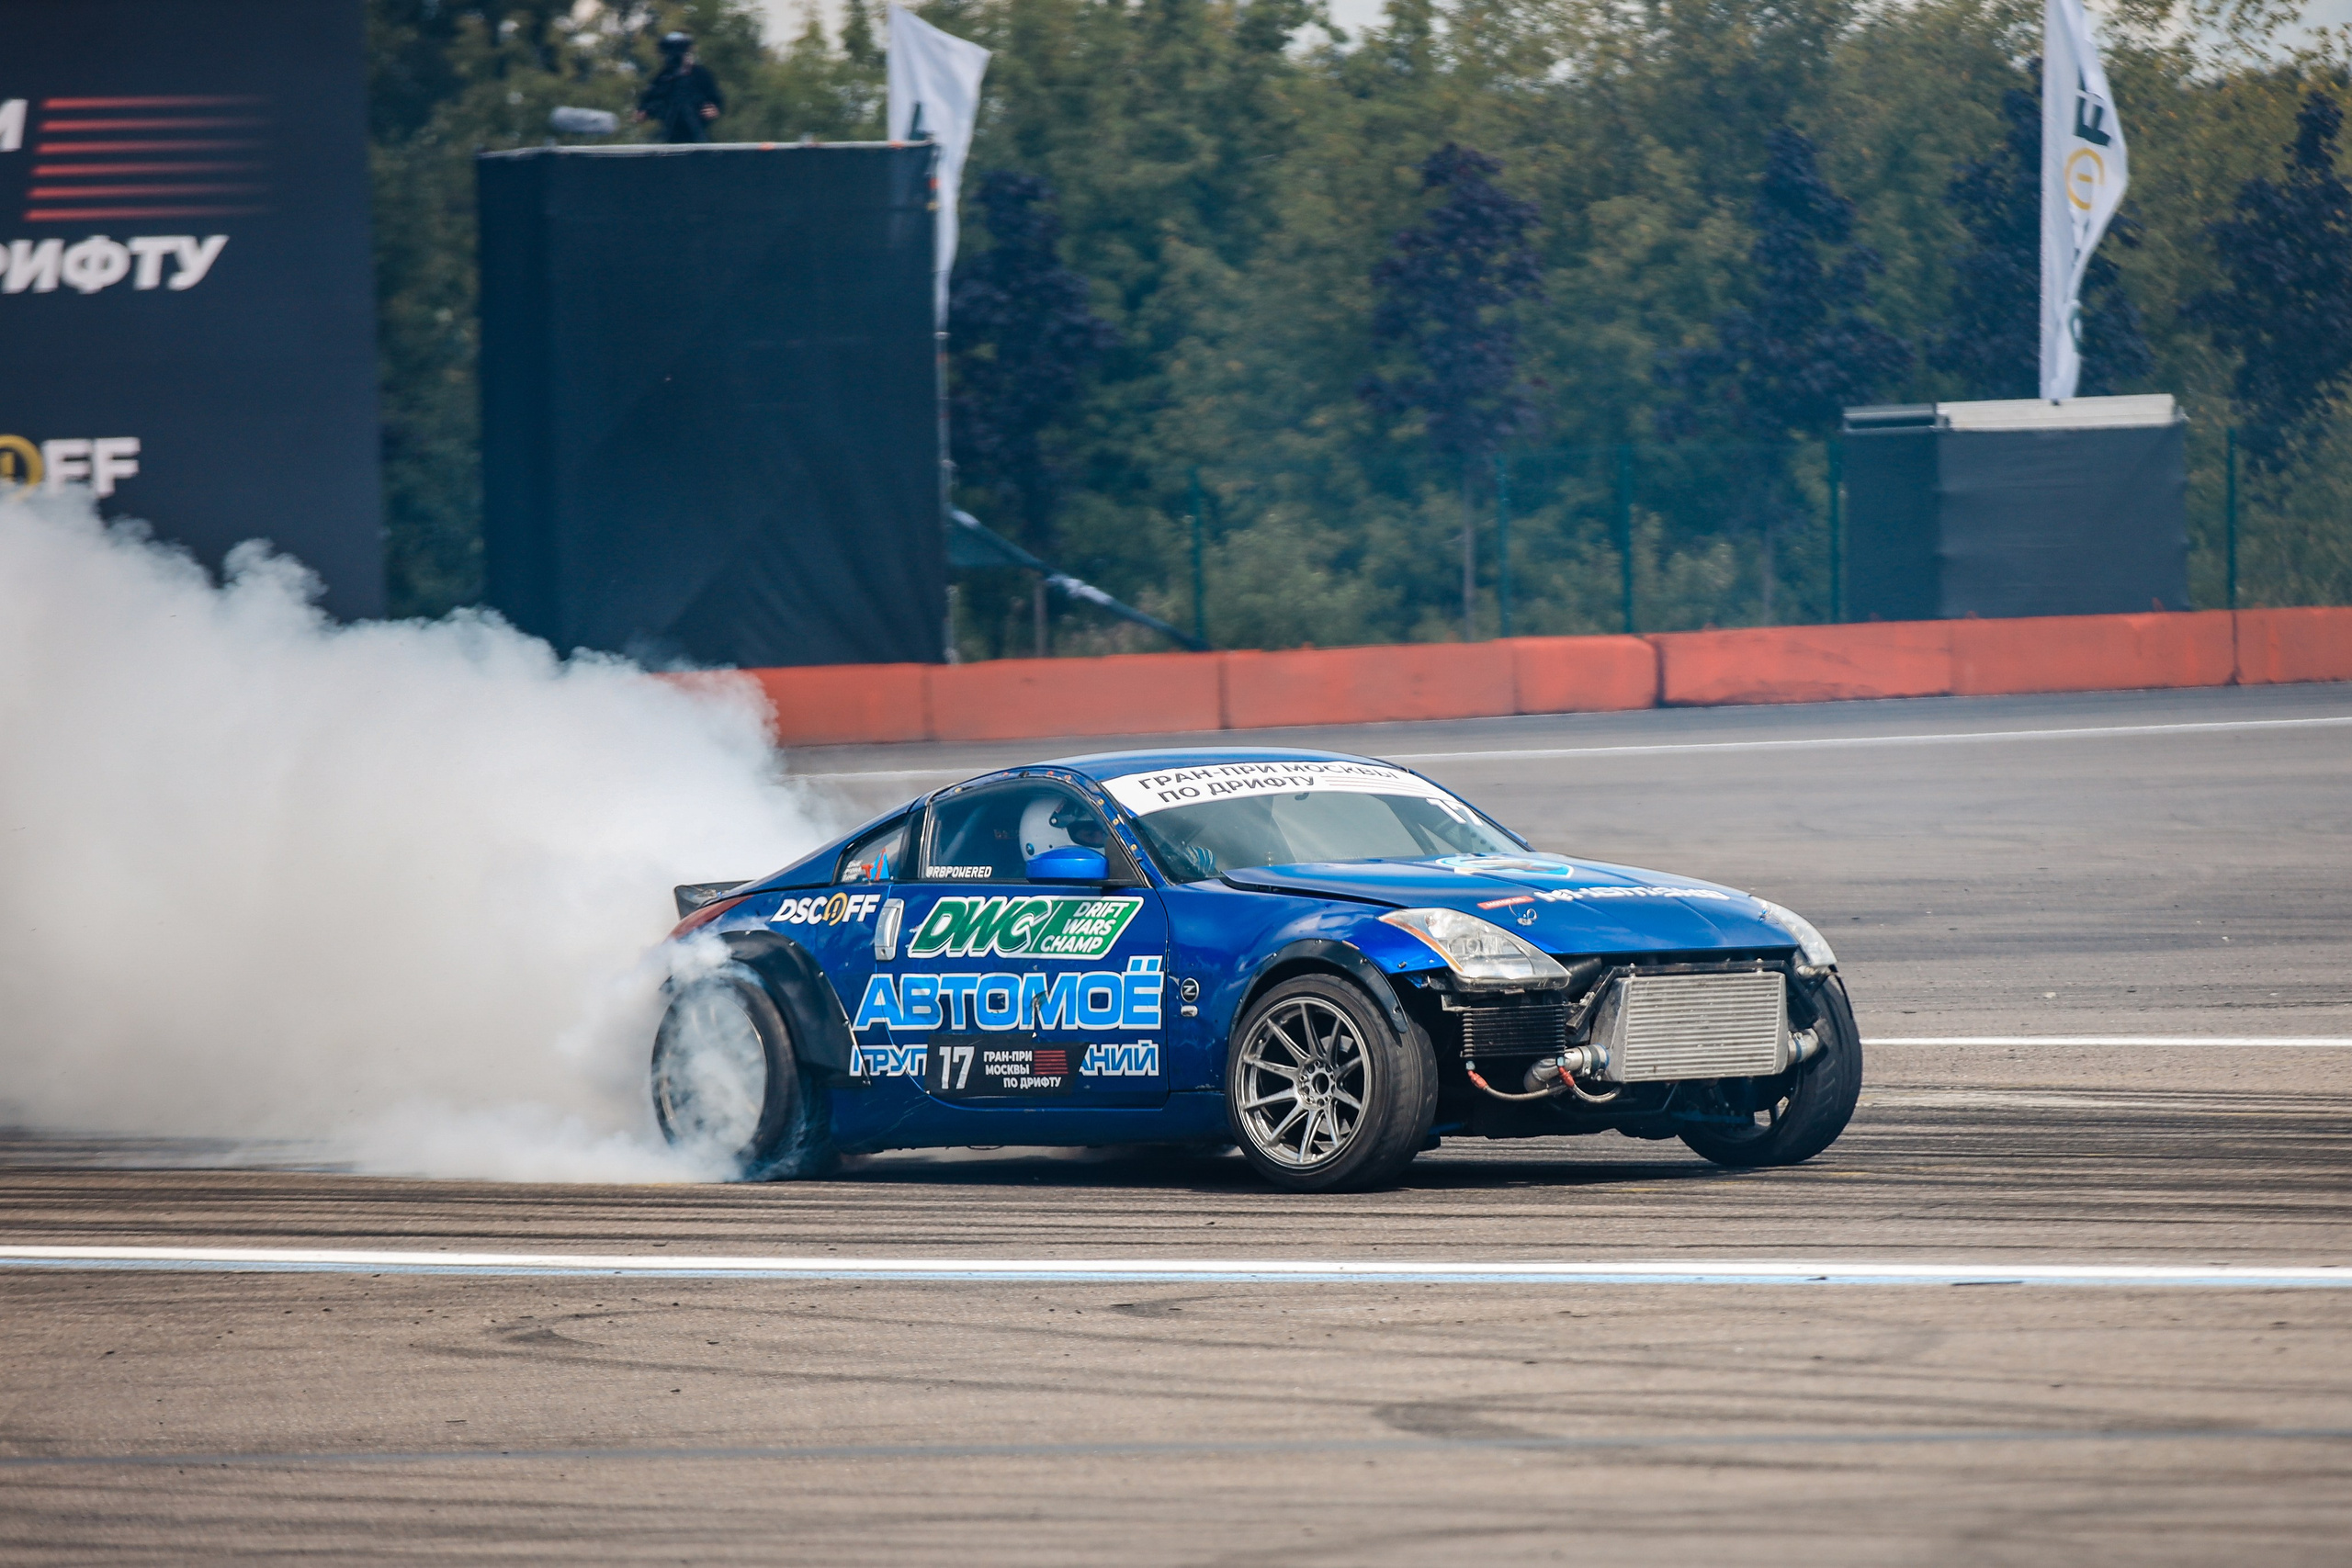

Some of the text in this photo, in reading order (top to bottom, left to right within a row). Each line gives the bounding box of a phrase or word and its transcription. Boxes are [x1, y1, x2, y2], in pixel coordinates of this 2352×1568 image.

[0, 234, 230, 294] ИФТУ
[1138, 763, 1399, 789] ГРАН-ПРИ МОСКВЫ
[1157, 776, 1315, 803] ПО ДРИФТУ
[1073, 901, 1130, 918] DRIFT
[910, 897, 1053, 958] DWC
[1062, 919, 1116, 935] WARS
[1040, 935, 1103, 953] CHAMP
[851, 955, 1164, 1031] АВТОМОЁ
[939, 1046, 975, 1089] 17
[983, 1050, 1033, 1063] ГРАН-ПРИ
[985, 1064, 1030, 1076] МОСКВЫ
[1003, 1076, 1062, 1089] ПО ДРИФТУ
